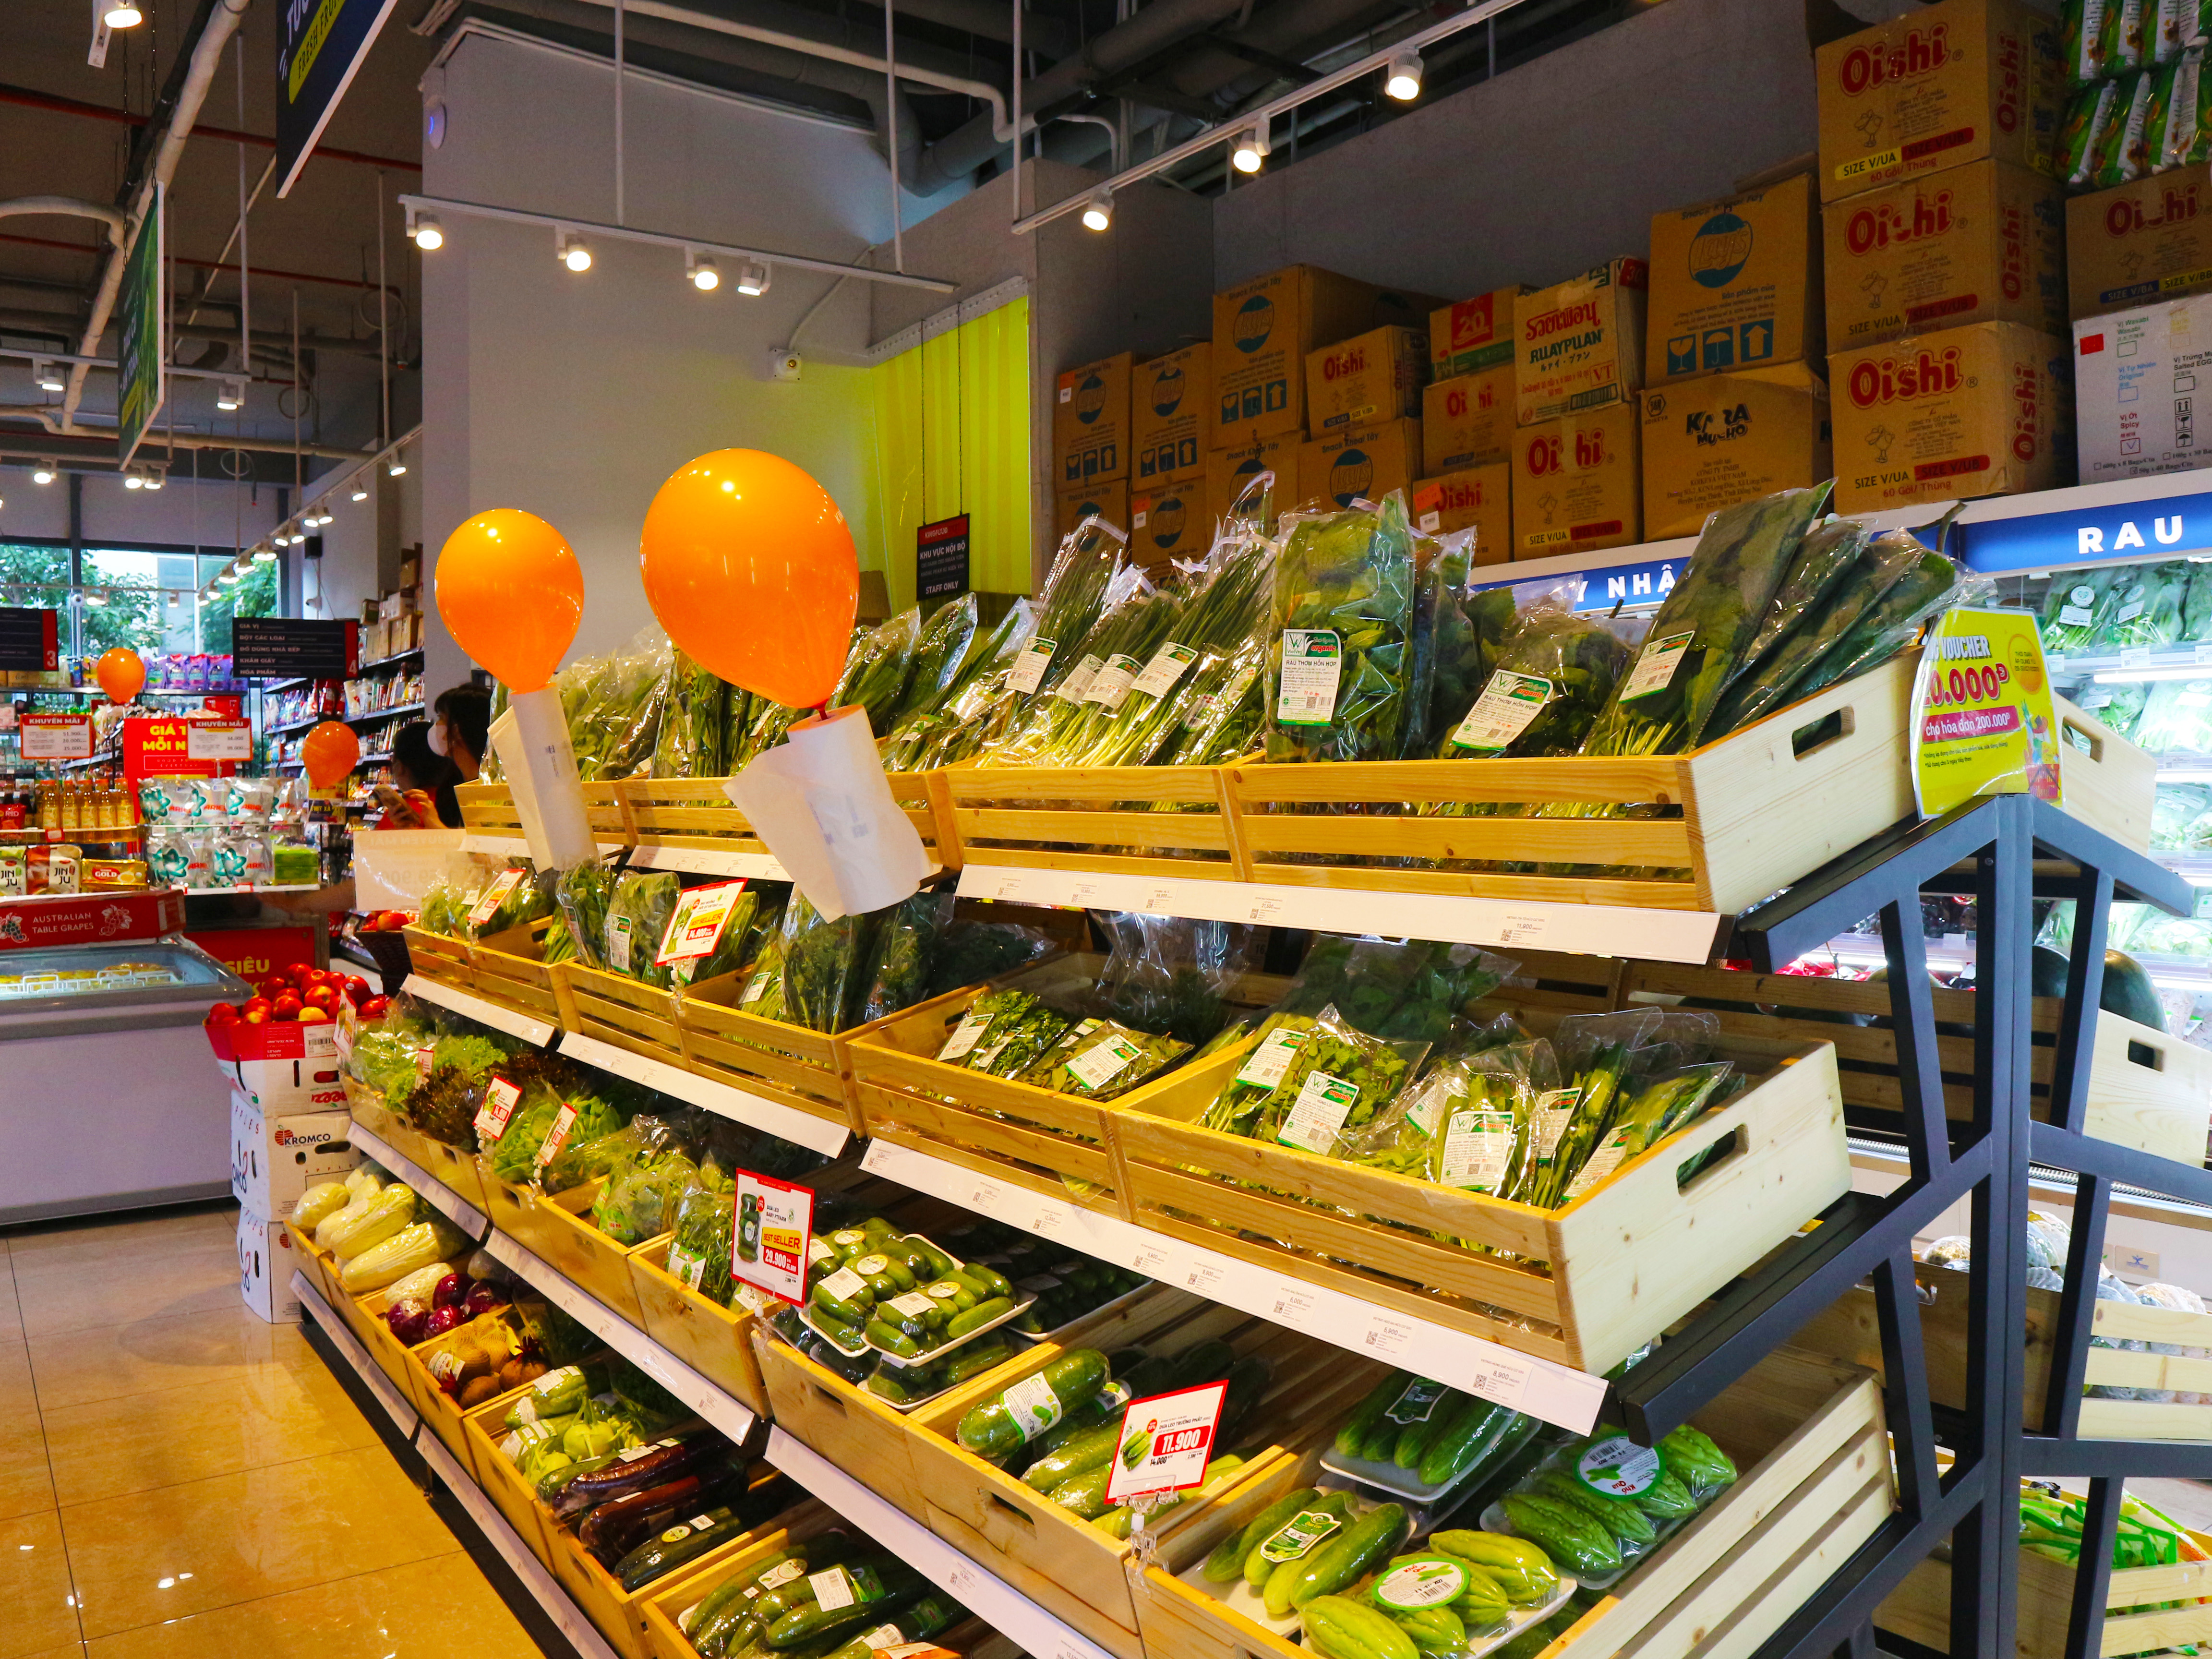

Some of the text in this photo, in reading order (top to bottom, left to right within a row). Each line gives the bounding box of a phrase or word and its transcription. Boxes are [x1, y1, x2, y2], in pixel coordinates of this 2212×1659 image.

[299, 24, 318, 79] FRESH
[1841, 26, 1946, 93] Oishi
[1996, 35, 2018, 132] Oishi
[1909, 132, 1964, 157] SIZE V/UB
[1844, 152, 1896, 176] SIZE V/UA
[1871, 172, 1882, 182] 60
[2001, 206, 2021, 300] Oishi
[2165, 270, 2212, 289] SIZE V/BB
[2109, 284, 2154, 301] SIZE V/BA
[1849, 315, 1901, 336] SIZE V/UA
[2117, 326, 2141, 335] Wasabi
[1529, 329, 1602, 364] RUAYPUAN
[1325, 349, 1364, 382] Oishi
[1593, 364, 1613, 381] VT
[2175, 358, 2212, 371] Salted EGG
[1850, 350, 1957, 406] Oishi
[2118, 372, 2145, 381] Original
[1447, 385, 1492, 417] Oihi
[2012, 365, 2036, 461] Oishi
[2121, 421, 2140, 430] Spicy
[1322, 442, 1343, 454] Snack
[1363, 432, 1380, 443] Tây
[1528, 432, 1602, 476] Oihi
[1922, 459, 1980, 477] SIZE V/UB
[1855, 471, 1909, 489] SIZE V/UA
[1434, 482, 1482, 512] Oishi
[1883, 480, 1952, 498] 60 Gói/ Thùng
[1529, 531, 1567, 545] SIZE V/UA
[2078, 515, 2183, 554] RAU
[920, 540, 966, 560] KHU VỰC NỘI BỘ
[926, 580, 959, 594] STAFF ONLY
[1608, 564, 1676, 599] NHẬ
[1310, 645, 1336, 653] organic
[1941, 634, 1992, 661] VOUCHER
[47, 650, 56, 667] 3
[349, 659, 358, 675] 4
[1516, 688, 1545, 698] organic
[149, 723, 176, 736] GIÁ
[1925, 717, 1975, 737] cho hóa đơn
[143, 736, 172, 751] MỖI
[0, 870, 15, 880] JIN
[54, 867, 68, 877] JIN
[95, 870, 118, 878] GOLD
[6, 878, 18, 888] JU
[59, 876, 71, 885] JU
[33, 913, 92, 924] AUSTRALIAN
[699, 912, 723, 924] SELLER
[32, 922, 94, 934] TABLE GRAPES
[225, 956, 270, 974] SIÊU
[1329, 1090, 1352, 1102] organic
[284, 1133, 331, 1145] KROMCO
[763, 1233, 800, 1249] BEST SELLER
[765, 1249, 786, 1269] 29.900
[1290, 1297, 1303, 1305] 6,000
[1383, 1326, 1398, 1335] 5,900
[1493, 1370, 1510, 1380] 8,900
[1176, 1418, 1191, 1427] TRƯỜNG
[1162, 1429, 1201, 1454] 11.900
[1150, 1456, 1167, 1467] 14.000
[1611, 1480, 1627, 1490] Qua
[1622, 1483, 1636, 1495] Khổ
[1403, 1563, 1418, 1573] Khổ
[1412, 1565, 1428, 1573] Qua
